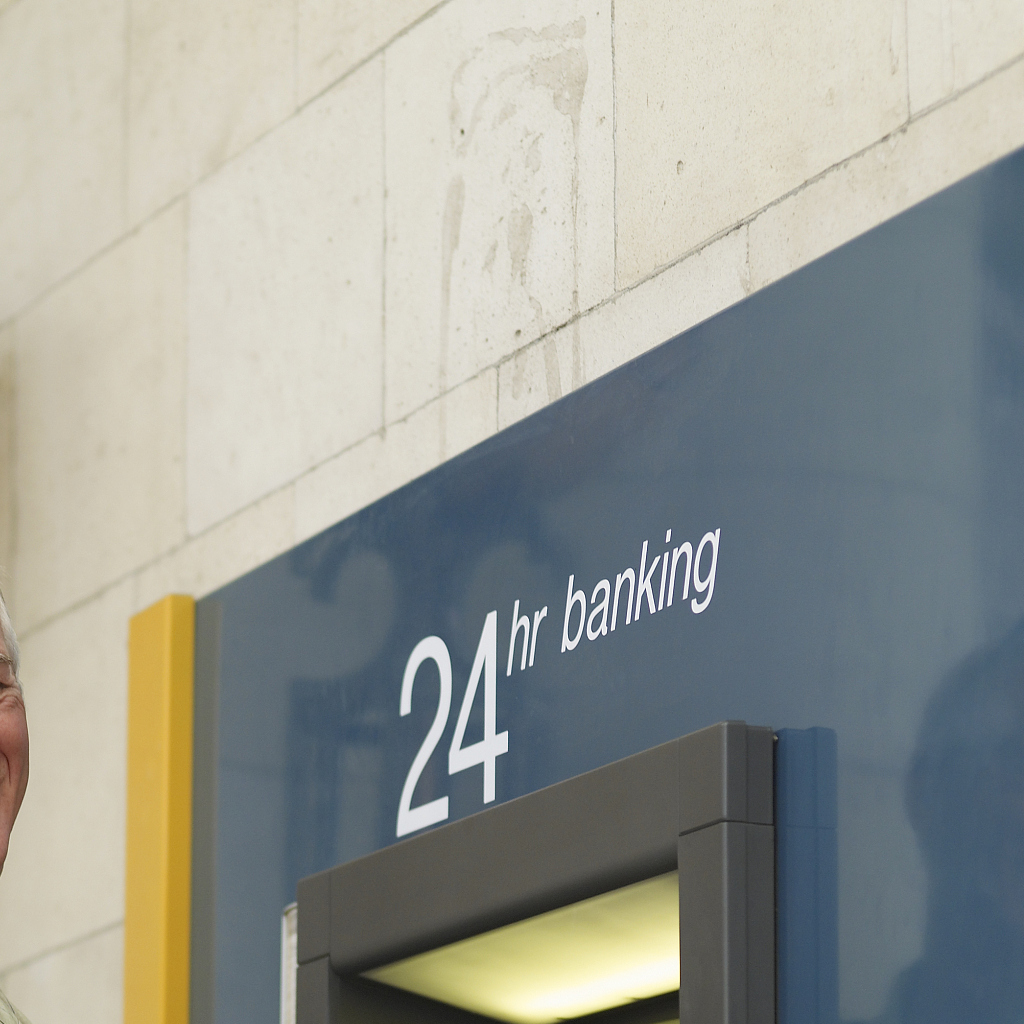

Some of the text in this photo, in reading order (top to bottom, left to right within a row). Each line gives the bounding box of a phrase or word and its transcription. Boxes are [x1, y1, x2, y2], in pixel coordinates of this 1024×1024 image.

[396, 527, 721, 838] 24 hr banking
